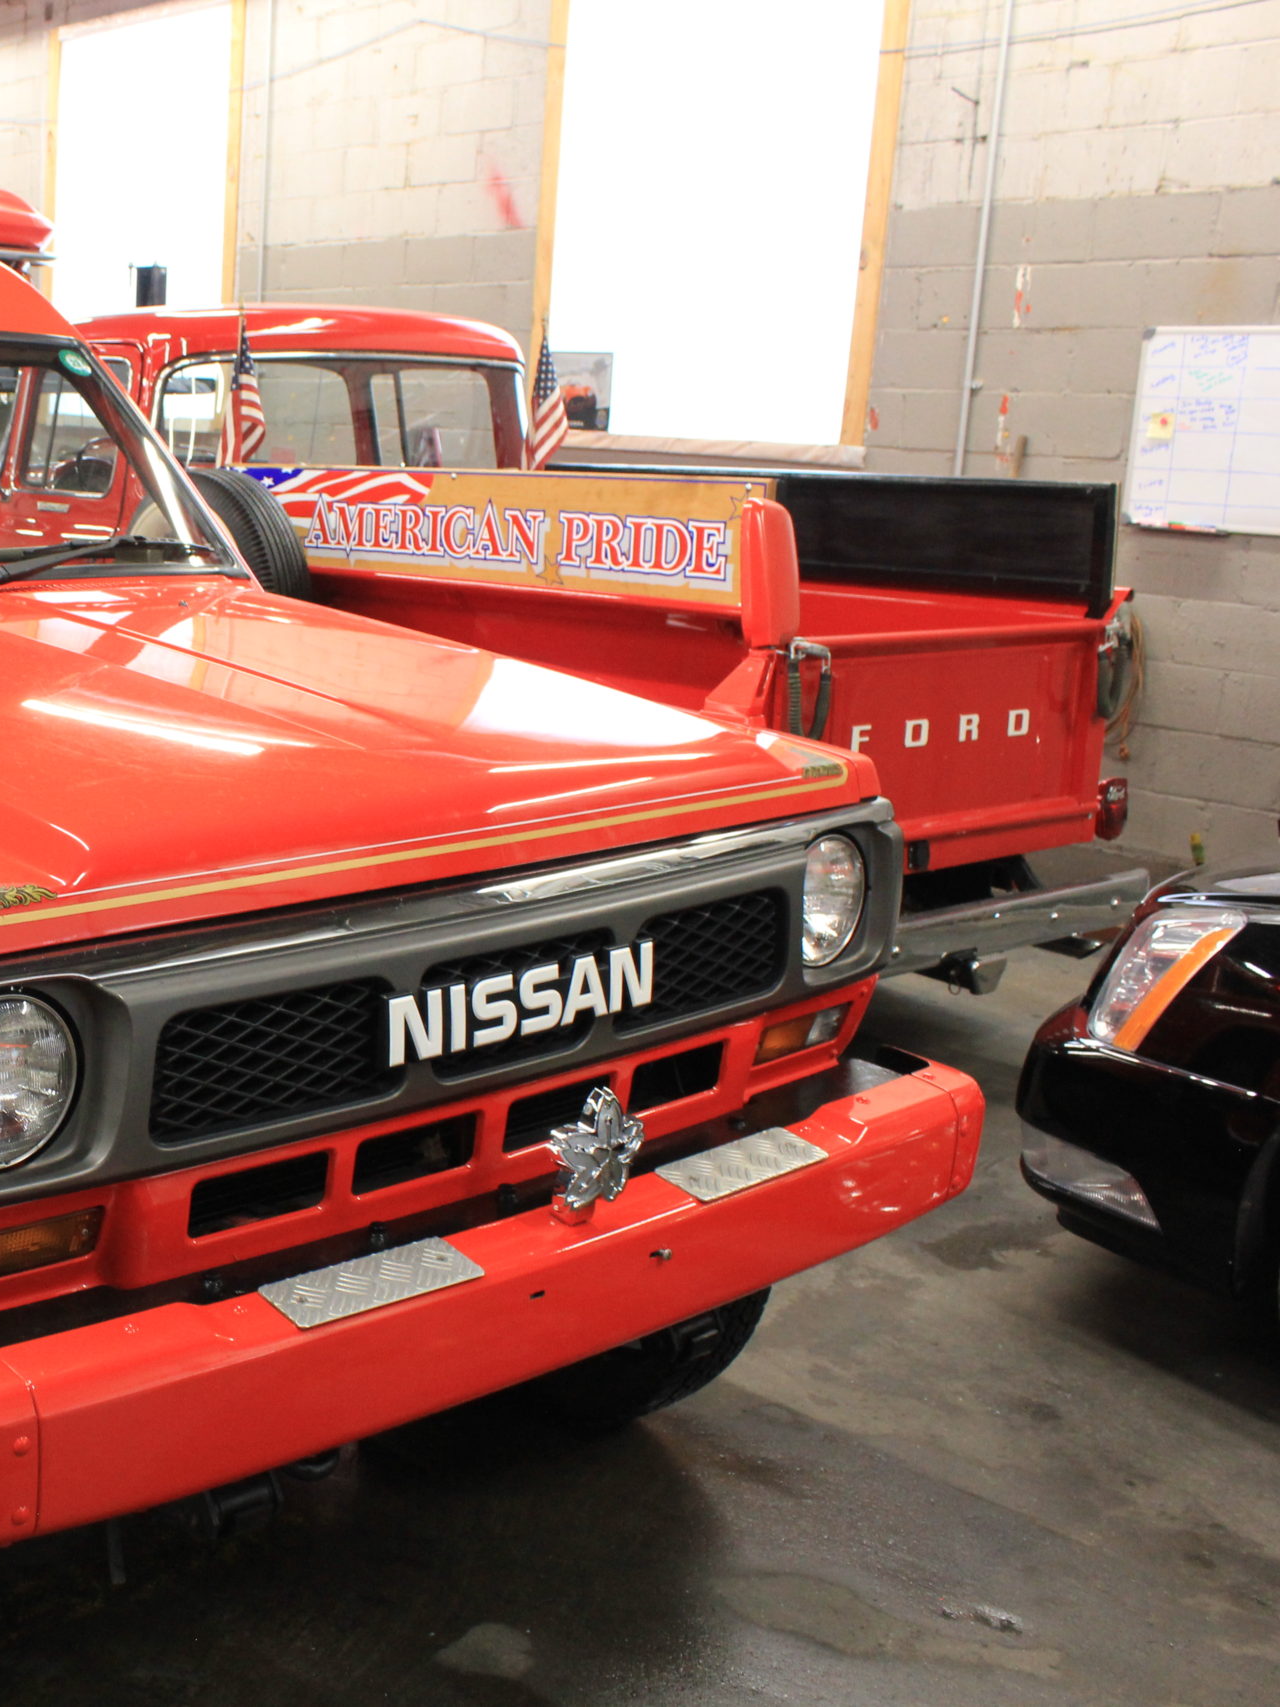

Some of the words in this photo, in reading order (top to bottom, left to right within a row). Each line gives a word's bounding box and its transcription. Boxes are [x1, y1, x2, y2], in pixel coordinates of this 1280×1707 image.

[304, 493, 546, 564] AMERICAN
[558, 510, 728, 581] PRIDE
[850, 708, 1030, 752] FORD
[385, 938, 655, 1068] NISSAN
